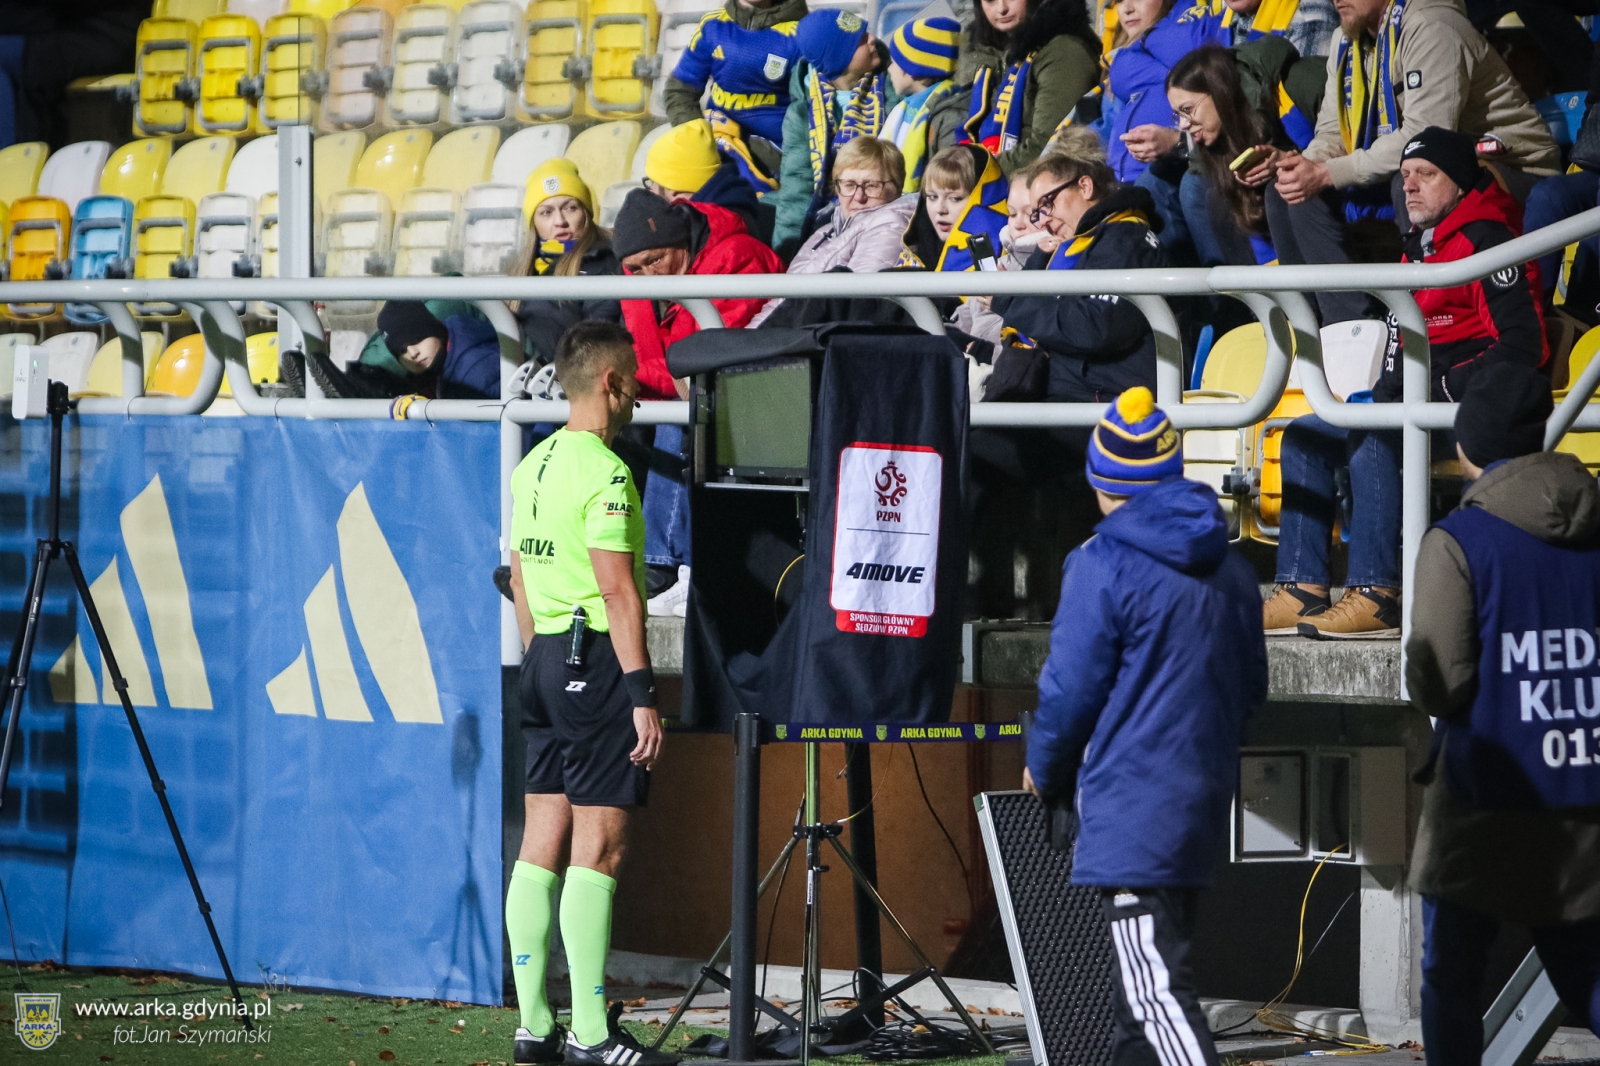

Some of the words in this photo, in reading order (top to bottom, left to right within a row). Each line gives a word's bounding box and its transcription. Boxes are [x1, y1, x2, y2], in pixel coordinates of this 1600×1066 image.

[876, 511, 901, 523] PZPN
[846, 562, 925, 584] 4MOVE
[850, 613, 882, 624] SPONSOR
[882, 614, 915, 626] GŁÓWNY
[855, 622, 887, 634] SĘDZIÓW
[887, 625, 909, 635] PZPN
[1501, 628, 1600, 673] MED
[801, 727, 826, 738] ARKA
[828, 728, 863, 739] GDYNIA
[900, 727, 926, 738] ARKA
[928, 727, 962, 738] GDYNIA
